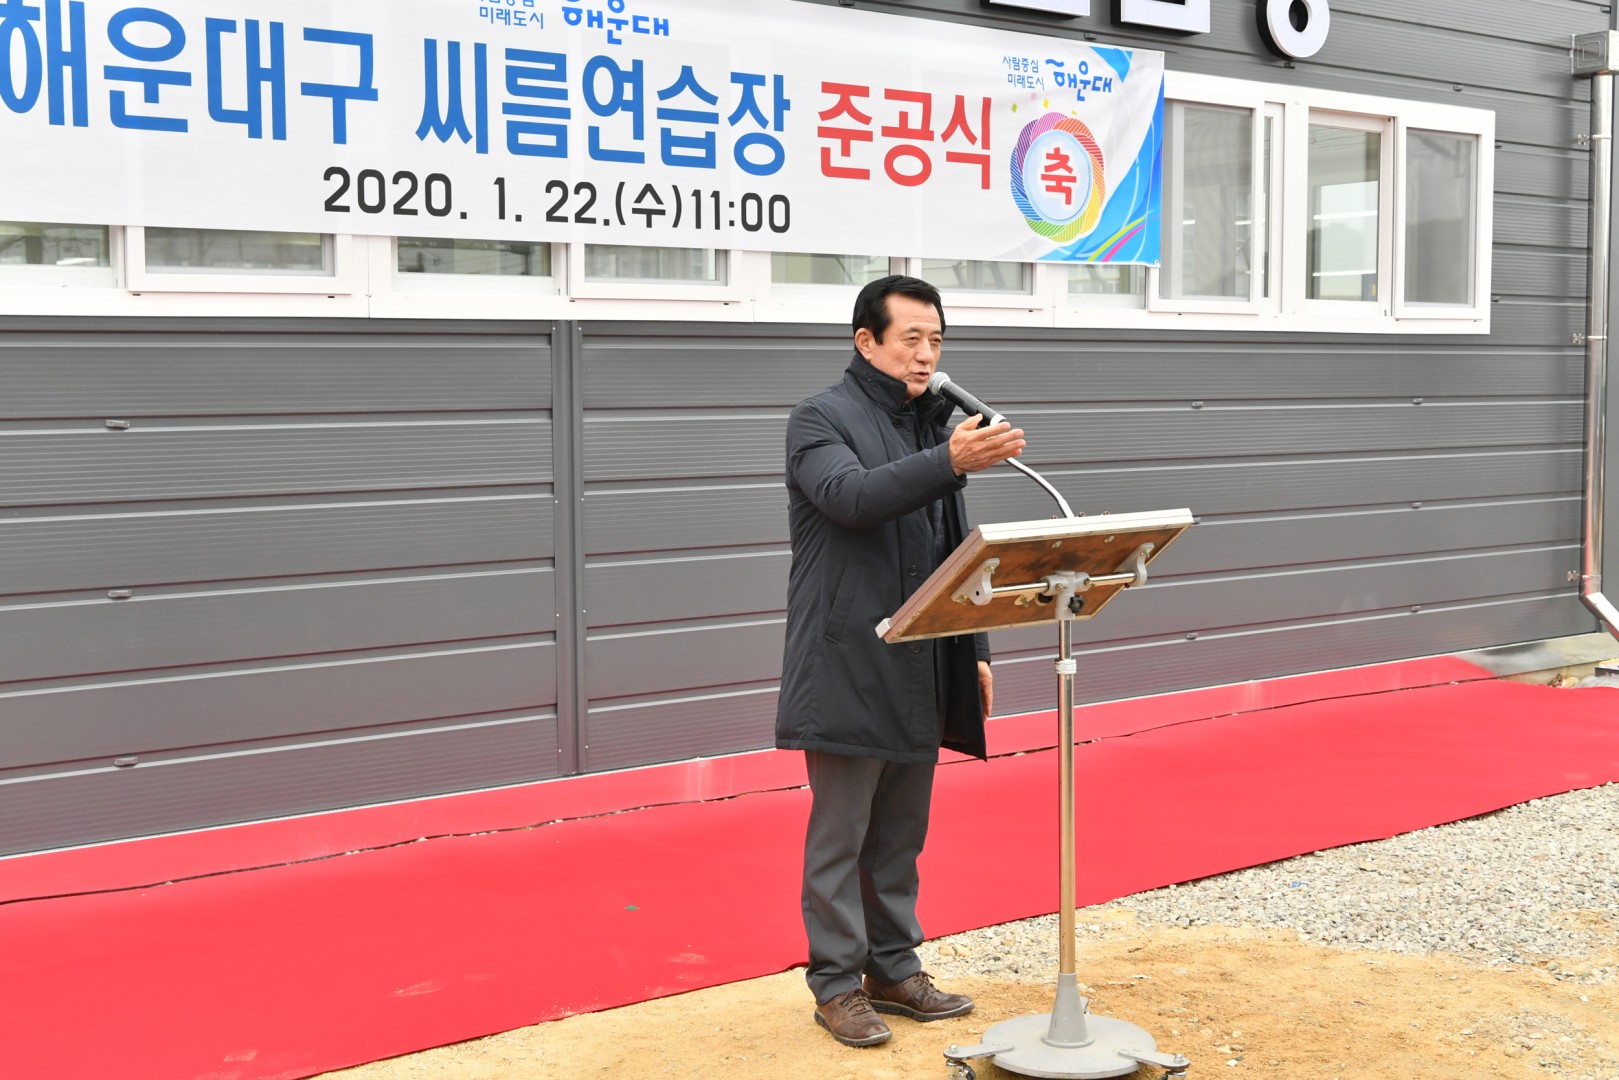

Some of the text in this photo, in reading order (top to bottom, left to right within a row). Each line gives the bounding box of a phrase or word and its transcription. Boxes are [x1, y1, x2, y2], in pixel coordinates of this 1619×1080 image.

[479, 6, 544, 30] 미래도시
[562, 0, 670, 46] 해운대
[1002, 56, 1039, 73] 사람중심
[1007, 73, 1045, 91] 미래도시
[1045, 59, 1113, 102] 해운대
[0, 0, 992, 190] 해운대구 씨름연습장 준공식
[323, 166, 468, 220] 2020.
[493, 177, 522, 222] 1.
[1041, 147, 1077, 206] 축
